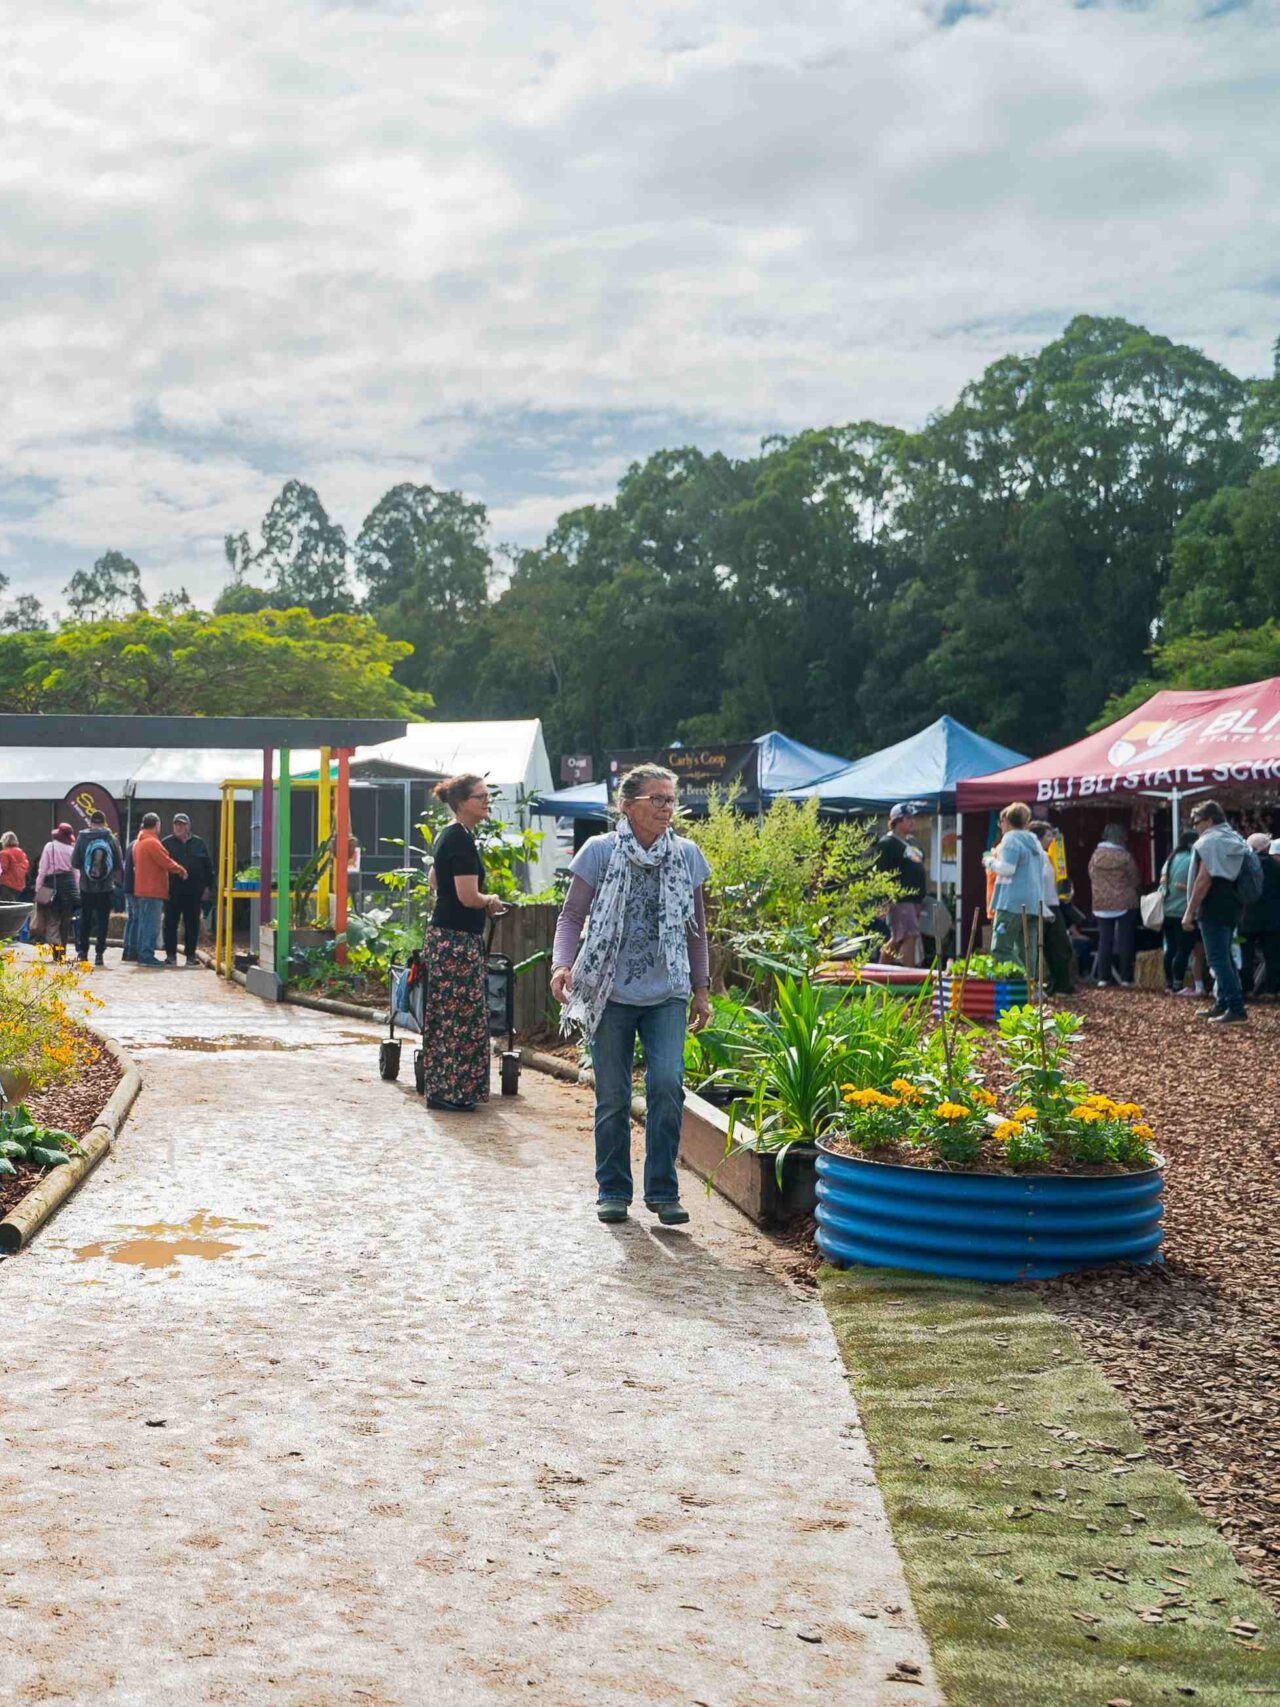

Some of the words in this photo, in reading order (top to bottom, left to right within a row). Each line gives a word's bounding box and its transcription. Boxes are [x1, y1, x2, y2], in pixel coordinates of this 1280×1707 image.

[567, 758, 588, 768] Oval
[668, 753, 699, 769] Carly's
[699, 752, 727, 768] Coop
[573, 769, 580, 778] 3
[1035, 778, 1072, 801] BLI
[1078, 774, 1117, 796] BLI
[1123, 764, 1206, 789] STATE
